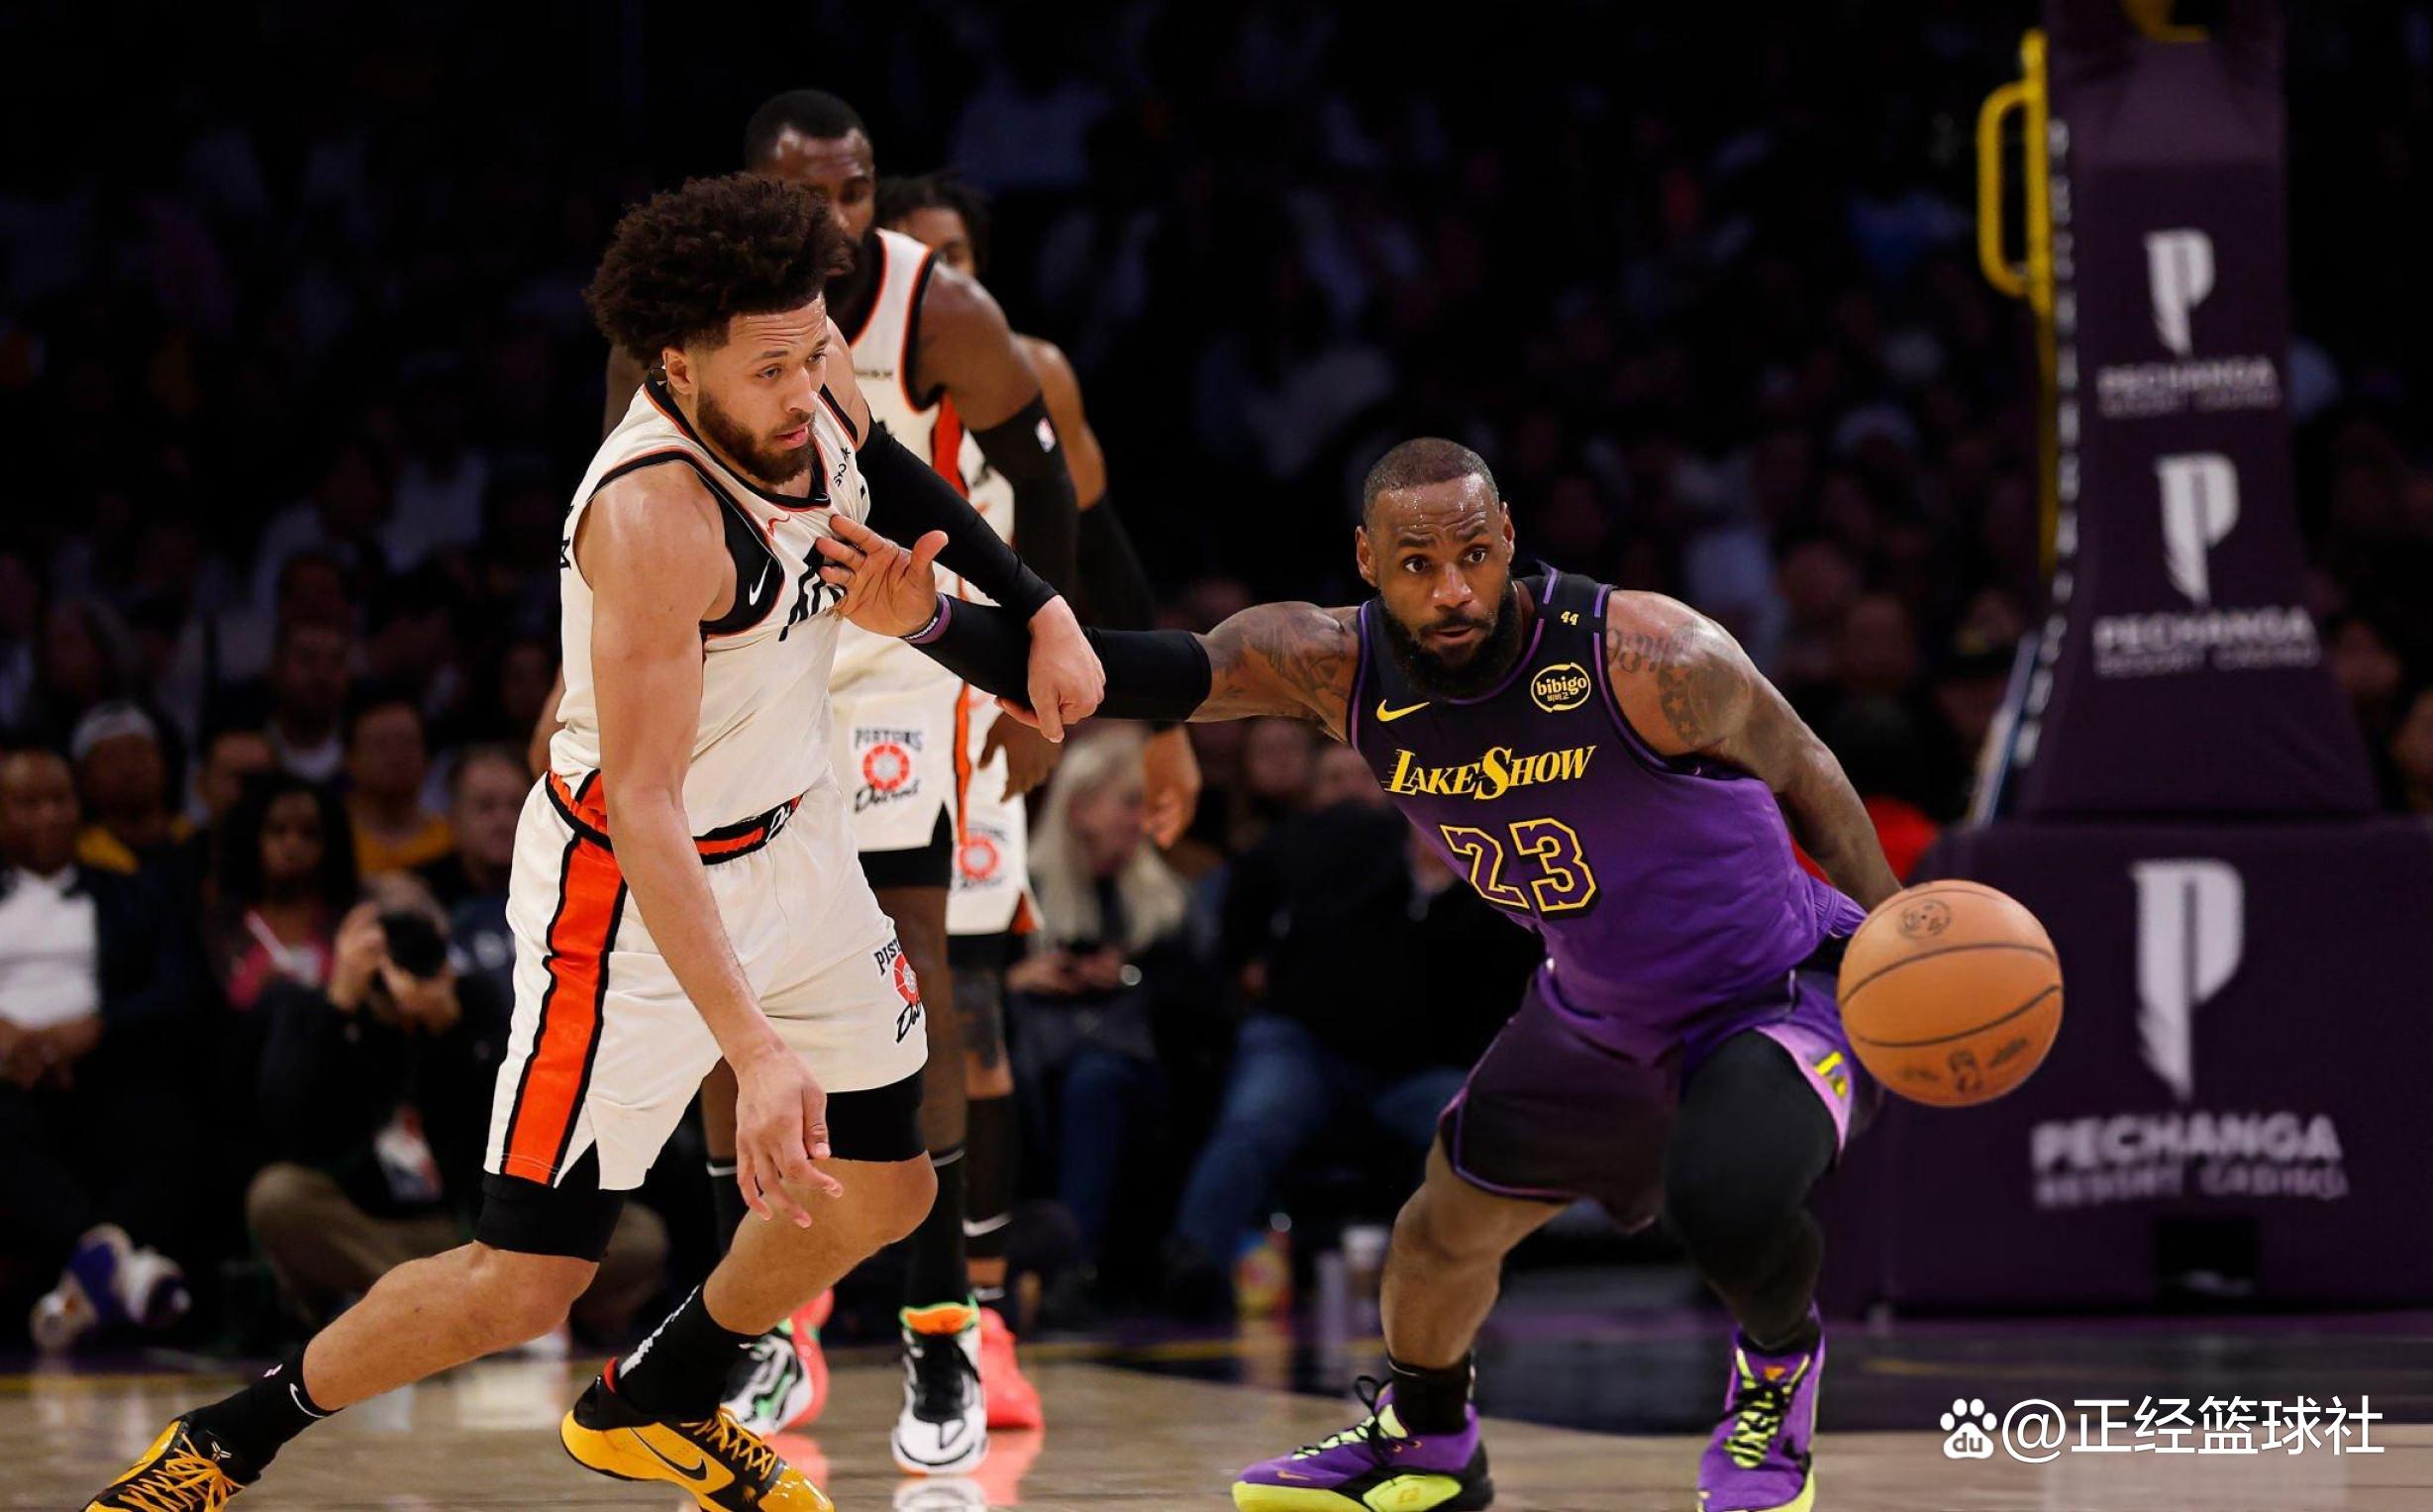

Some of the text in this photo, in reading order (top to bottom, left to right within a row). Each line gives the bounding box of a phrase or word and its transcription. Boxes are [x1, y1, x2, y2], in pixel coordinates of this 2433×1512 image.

[1560, 610, 1580, 626] 44
[1536, 675, 1588, 697] bibigo
[1439, 818, 1597, 912] 23
[2031, 1111, 2343, 1168] PECHANGA
